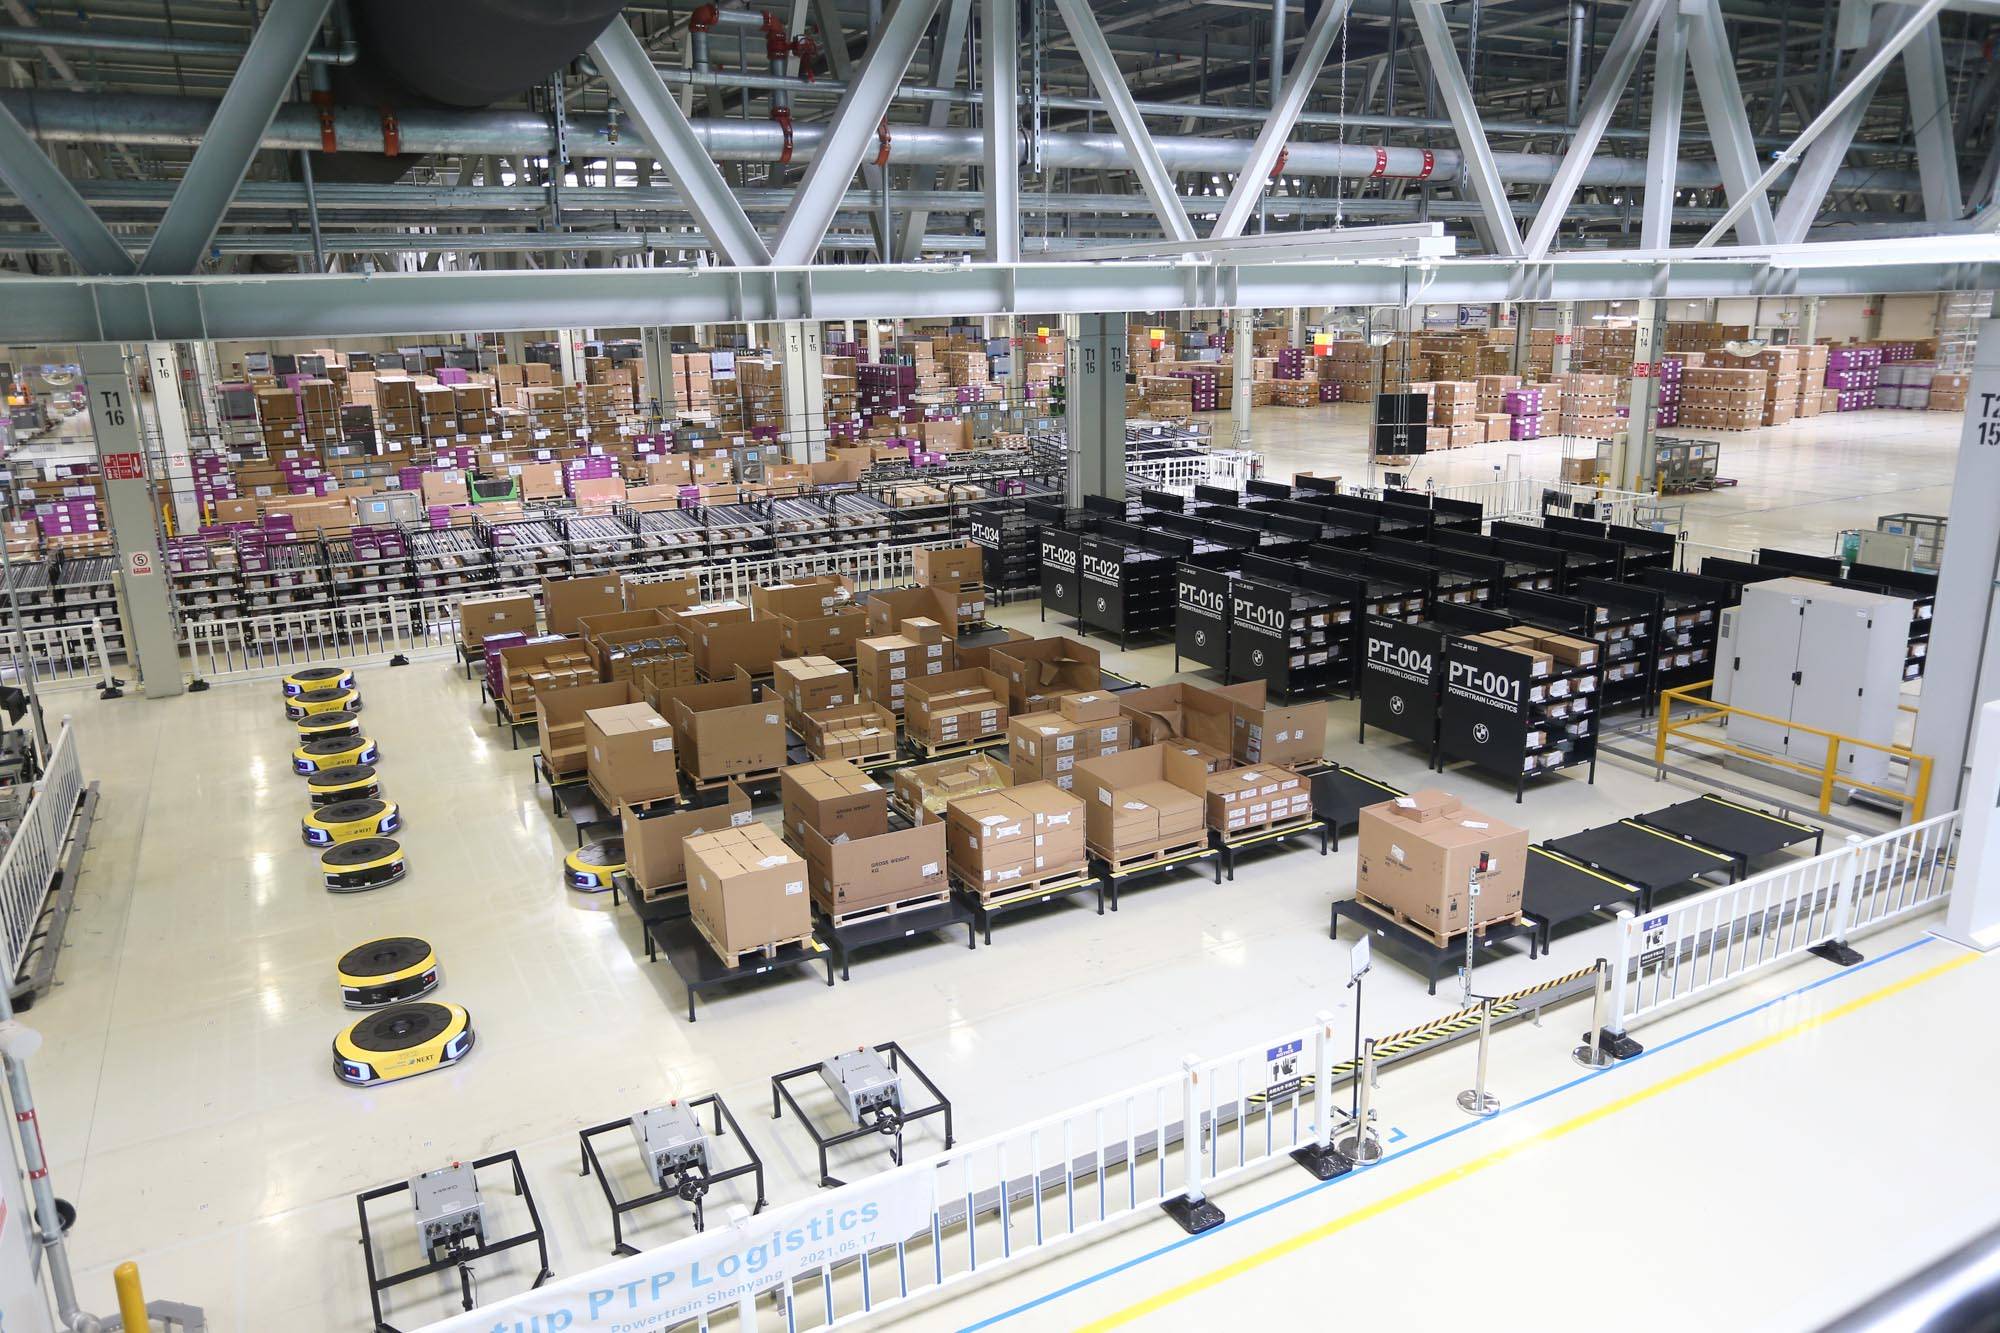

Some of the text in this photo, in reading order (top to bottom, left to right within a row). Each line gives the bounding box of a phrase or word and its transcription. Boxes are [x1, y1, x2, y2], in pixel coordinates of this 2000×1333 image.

[809, 335, 815, 343] T
[1641, 328, 1649, 338] T1
[809, 344, 817, 352] 15
[1640, 338, 1648, 347] 14
[1085, 348, 1095, 360] T1
[1111, 347, 1121, 359] T1
[157, 358, 165, 367] T
[1086, 362, 1095, 374] 15
[1111, 361, 1121, 373] 15
[158, 369, 169, 378] 16
[101, 391, 121, 409] T1
[105, 410, 125, 426] 16
[1978, 422, 2000, 446] 15
[972, 522, 1000, 543] PT-034
[137, 556, 144, 565] 5
[1042, 543, 1076, 566] PT-028
[1083, 555, 1120, 579] PT-022
[1179, 582, 1223, 611] PT-016
[1179, 603, 1222, 621] POWERTRAIN LOGISTICS
[1234, 598, 1285, 629] PT-010
[1234, 620, 1282, 639] POWERTRAIN LOGISTICS
[1368, 637, 1432, 674] PT-004
[1367, 662, 1429, 686] POWERTRAIN LOGISTICS
[1448, 660, 1520, 702] PT-001
[1448, 686, 1518, 714] POWERTRAIN LOGISTICS
[416, 1055, 434, 1064] NEXT
[1276, 1049, 1294, 1058] NOTICE
[588, 1270, 676, 1321] PTP
[691, 1201, 880, 1288] Logistics
[611, 1231, 878, 1333] Powertrain Shenyang 2021.05.17
